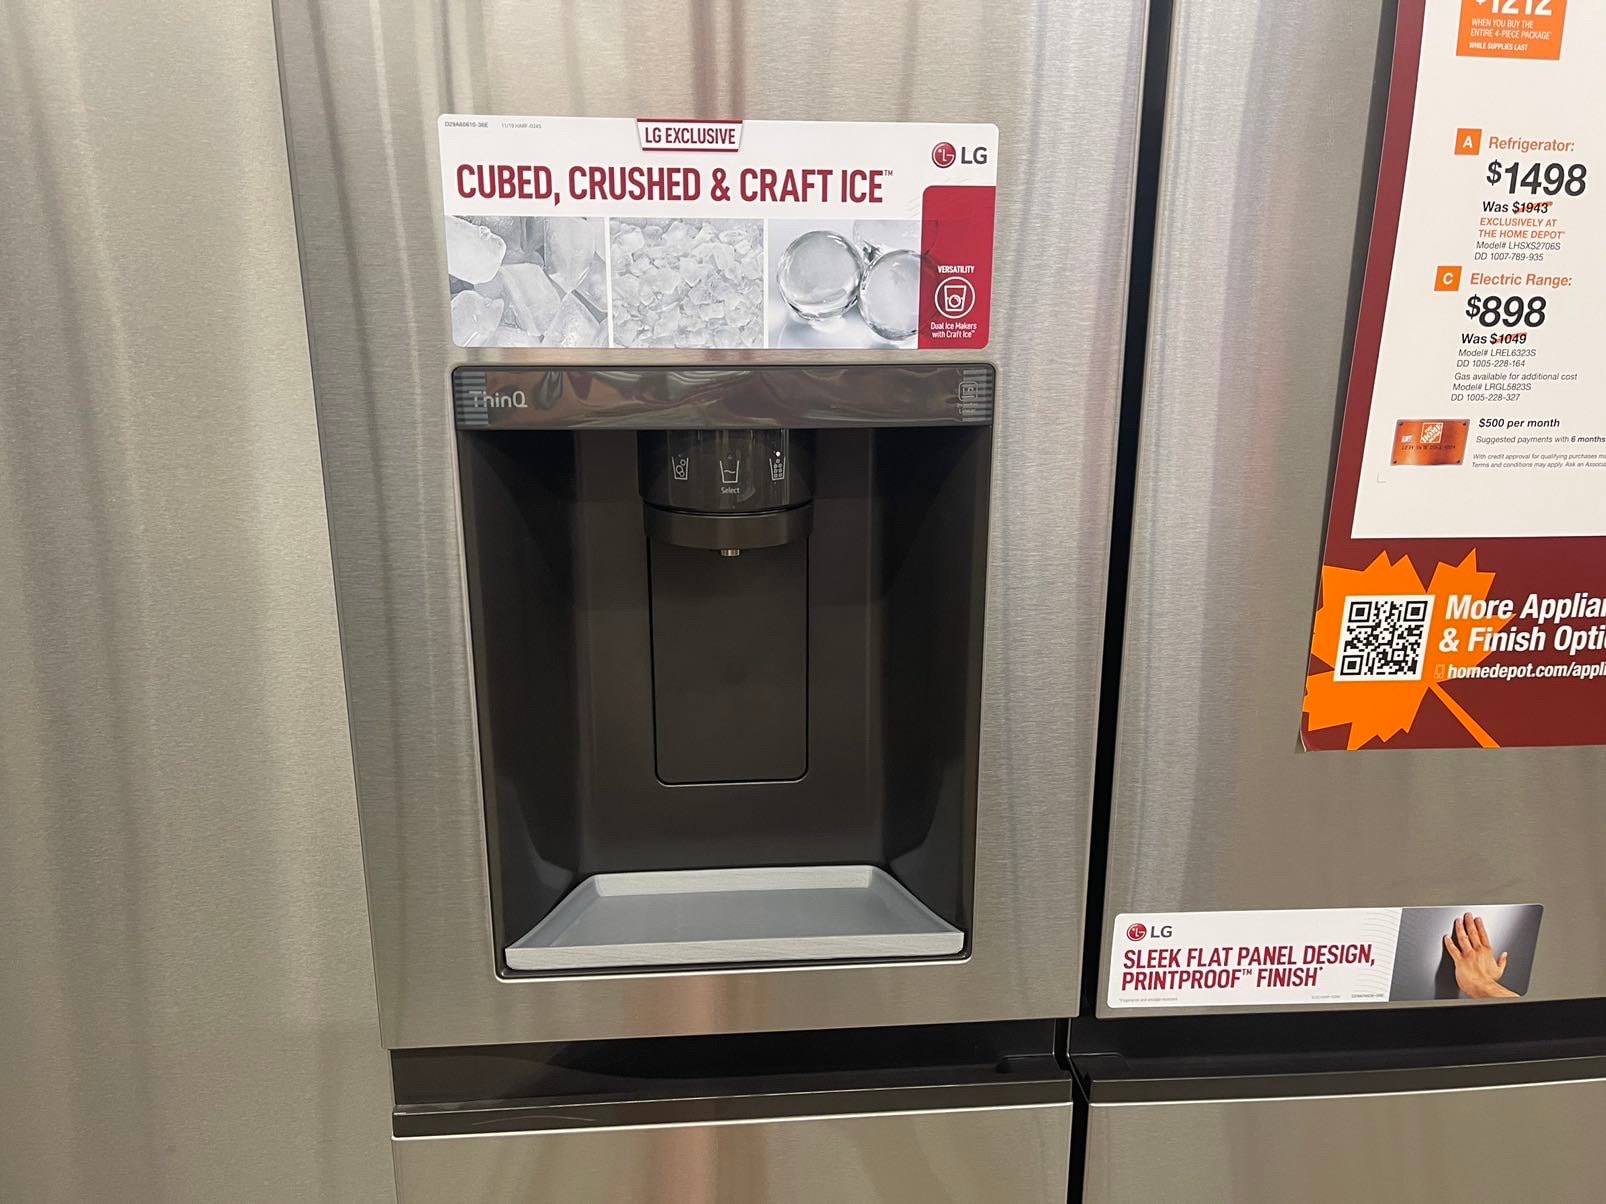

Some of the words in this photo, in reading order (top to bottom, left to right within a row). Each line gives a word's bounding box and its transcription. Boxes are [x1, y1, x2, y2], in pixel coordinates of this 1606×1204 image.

[1472, 18, 1491, 27] WHEN
[1492, 18, 1506, 27] YOU
[1507, 19, 1521, 28] BUY
[1521, 20, 1534, 29] THE
[1470, 28, 1493, 37] ENTIRE
[1494, 29, 1520, 39] 4-PIECE
[645, 127, 662, 144] LG
[665, 128, 736, 145] EXCLUSIVE
[1462, 136, 1473, 149] A
[1489, 136, 1575, 153] Refrigerator:
[961, 146, 988, 165] LG
[1486, 159, 1587, 197] $1498
[456, 164, 560, 206] CUBED,
[568, 166, 701, 201] CRUSHED
[710, 168, 731, 202] &
[740, 169, 833, 202] CRAFT
[1482, 201, 1509, 212] Was
[1512, 201, 1549, 214] $1943
[1479, 217, 1543, 227] EXCLUSIVELY
[1545, 219, 1557, 227] AT
[1478, 229, 1497, 238] THE
[1499, 230, 1528, 239] HOME
[1476, 241, 1506, 250] Model#
[1508, 242, 1561, 251] LHSXS2706S
[1474, 252, 1488, 261] DD
[1490, 252, 1544, 262] 1007-789-935
[937, 265, 975, 274] VERSATILITY
[1443, 272, 1454, 285] C
[1470, 272, 1522, 286] Electric
[1525, 273, 1572, 289] Range:
[1466, 294, 1547, 328] $898
[930, 321, 945, 330] Dual
[945, 322, 955, 330] Ice
[955, 322, 977, 330] Makers
[931, 330, 945, 338] with
[946, 330, 962, 338] Craft
[1461, 333, 1487, 345] Was
[1489, 333, 1528, 345] $1049
[1458, 349, 1488, 357] Model#
[1490, 349, 1537, 357] LREL6323S
[1456, 359, 1470, 368] DD
[1472, 359, 1525, 368] 1005-228-164
[1454, 372, 1471, 381] Gas
[1472, 372, 1507, 381] available
[1508, 373, 1520, 381] for
[1521, 373, 1560, 381] additional
[1561, 373, 1578, 381] cost
[1452, 383, 1482, 391] Model#
[1484, 383, 1532, 391] LRGL5823S
[468, 390, 528, 408] ThinQ
[1450, 393, 1464, 402] DD
[1466, 393, 1521, 402] 1005-228-327
[1478, 418, 1505, 428] $500
[1507, 419, 1525, 430] per
[1527, 418, 1560, 428] month
[1475, 435, 1517, 445] Suggested
[1517, 436, 1552, 445] payments
[1570, 435, 1576, 443] 6
[1505, 453, 1530, 461] approval
[1540, 453, 1568, 461] qualifying
[1445, 594, 1514, 620] More
[1438, 627, 1460, 653] &
[1467, 627, 1547, 652] Finish
[1554, 625, 1606, 656] Opti
[1150, 925, 1172, 938] LG
[1122, 948, 1182, 969] SLEEK
[1186, 947, 1231, 968] FLAT
[1237, 945, 1297, 967] PANEL
[1303, 943, 1376, 967] DESIGN,
